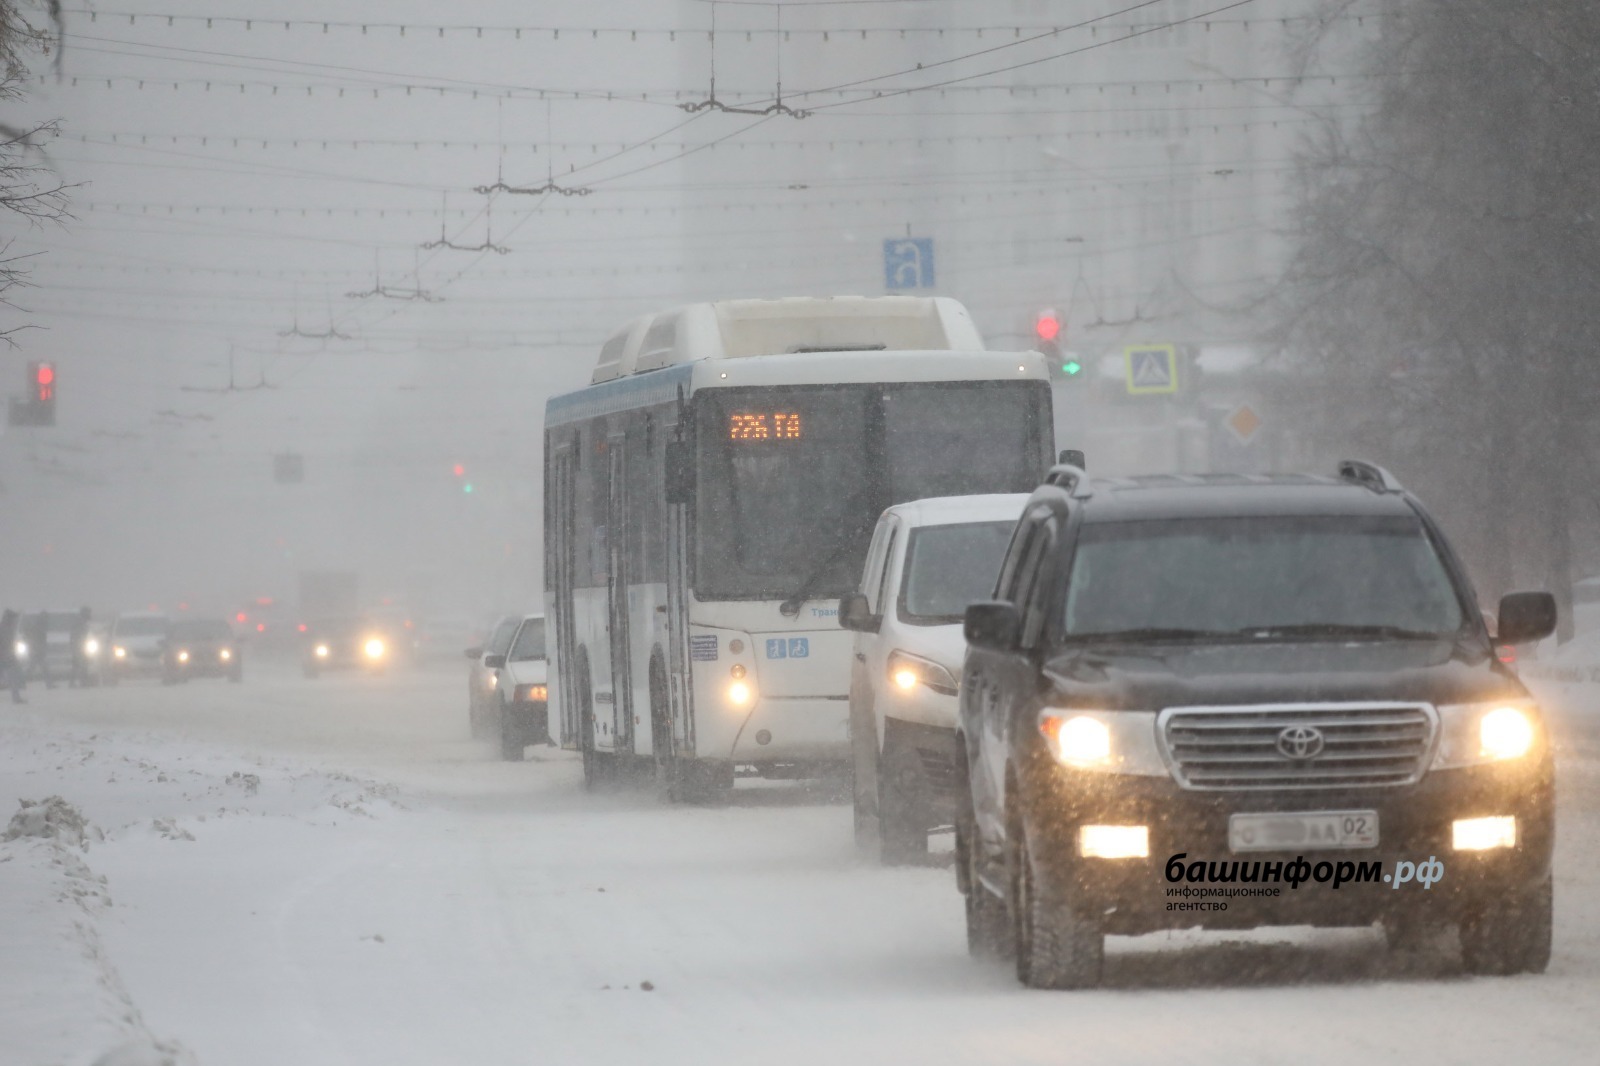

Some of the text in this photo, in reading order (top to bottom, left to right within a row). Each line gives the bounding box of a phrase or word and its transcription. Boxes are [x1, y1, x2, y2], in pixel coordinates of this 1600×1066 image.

[731, 414, 767, 438] 226
[811, 607, 840, 617] Тран
[1343, 817, 1366, 836] 02
